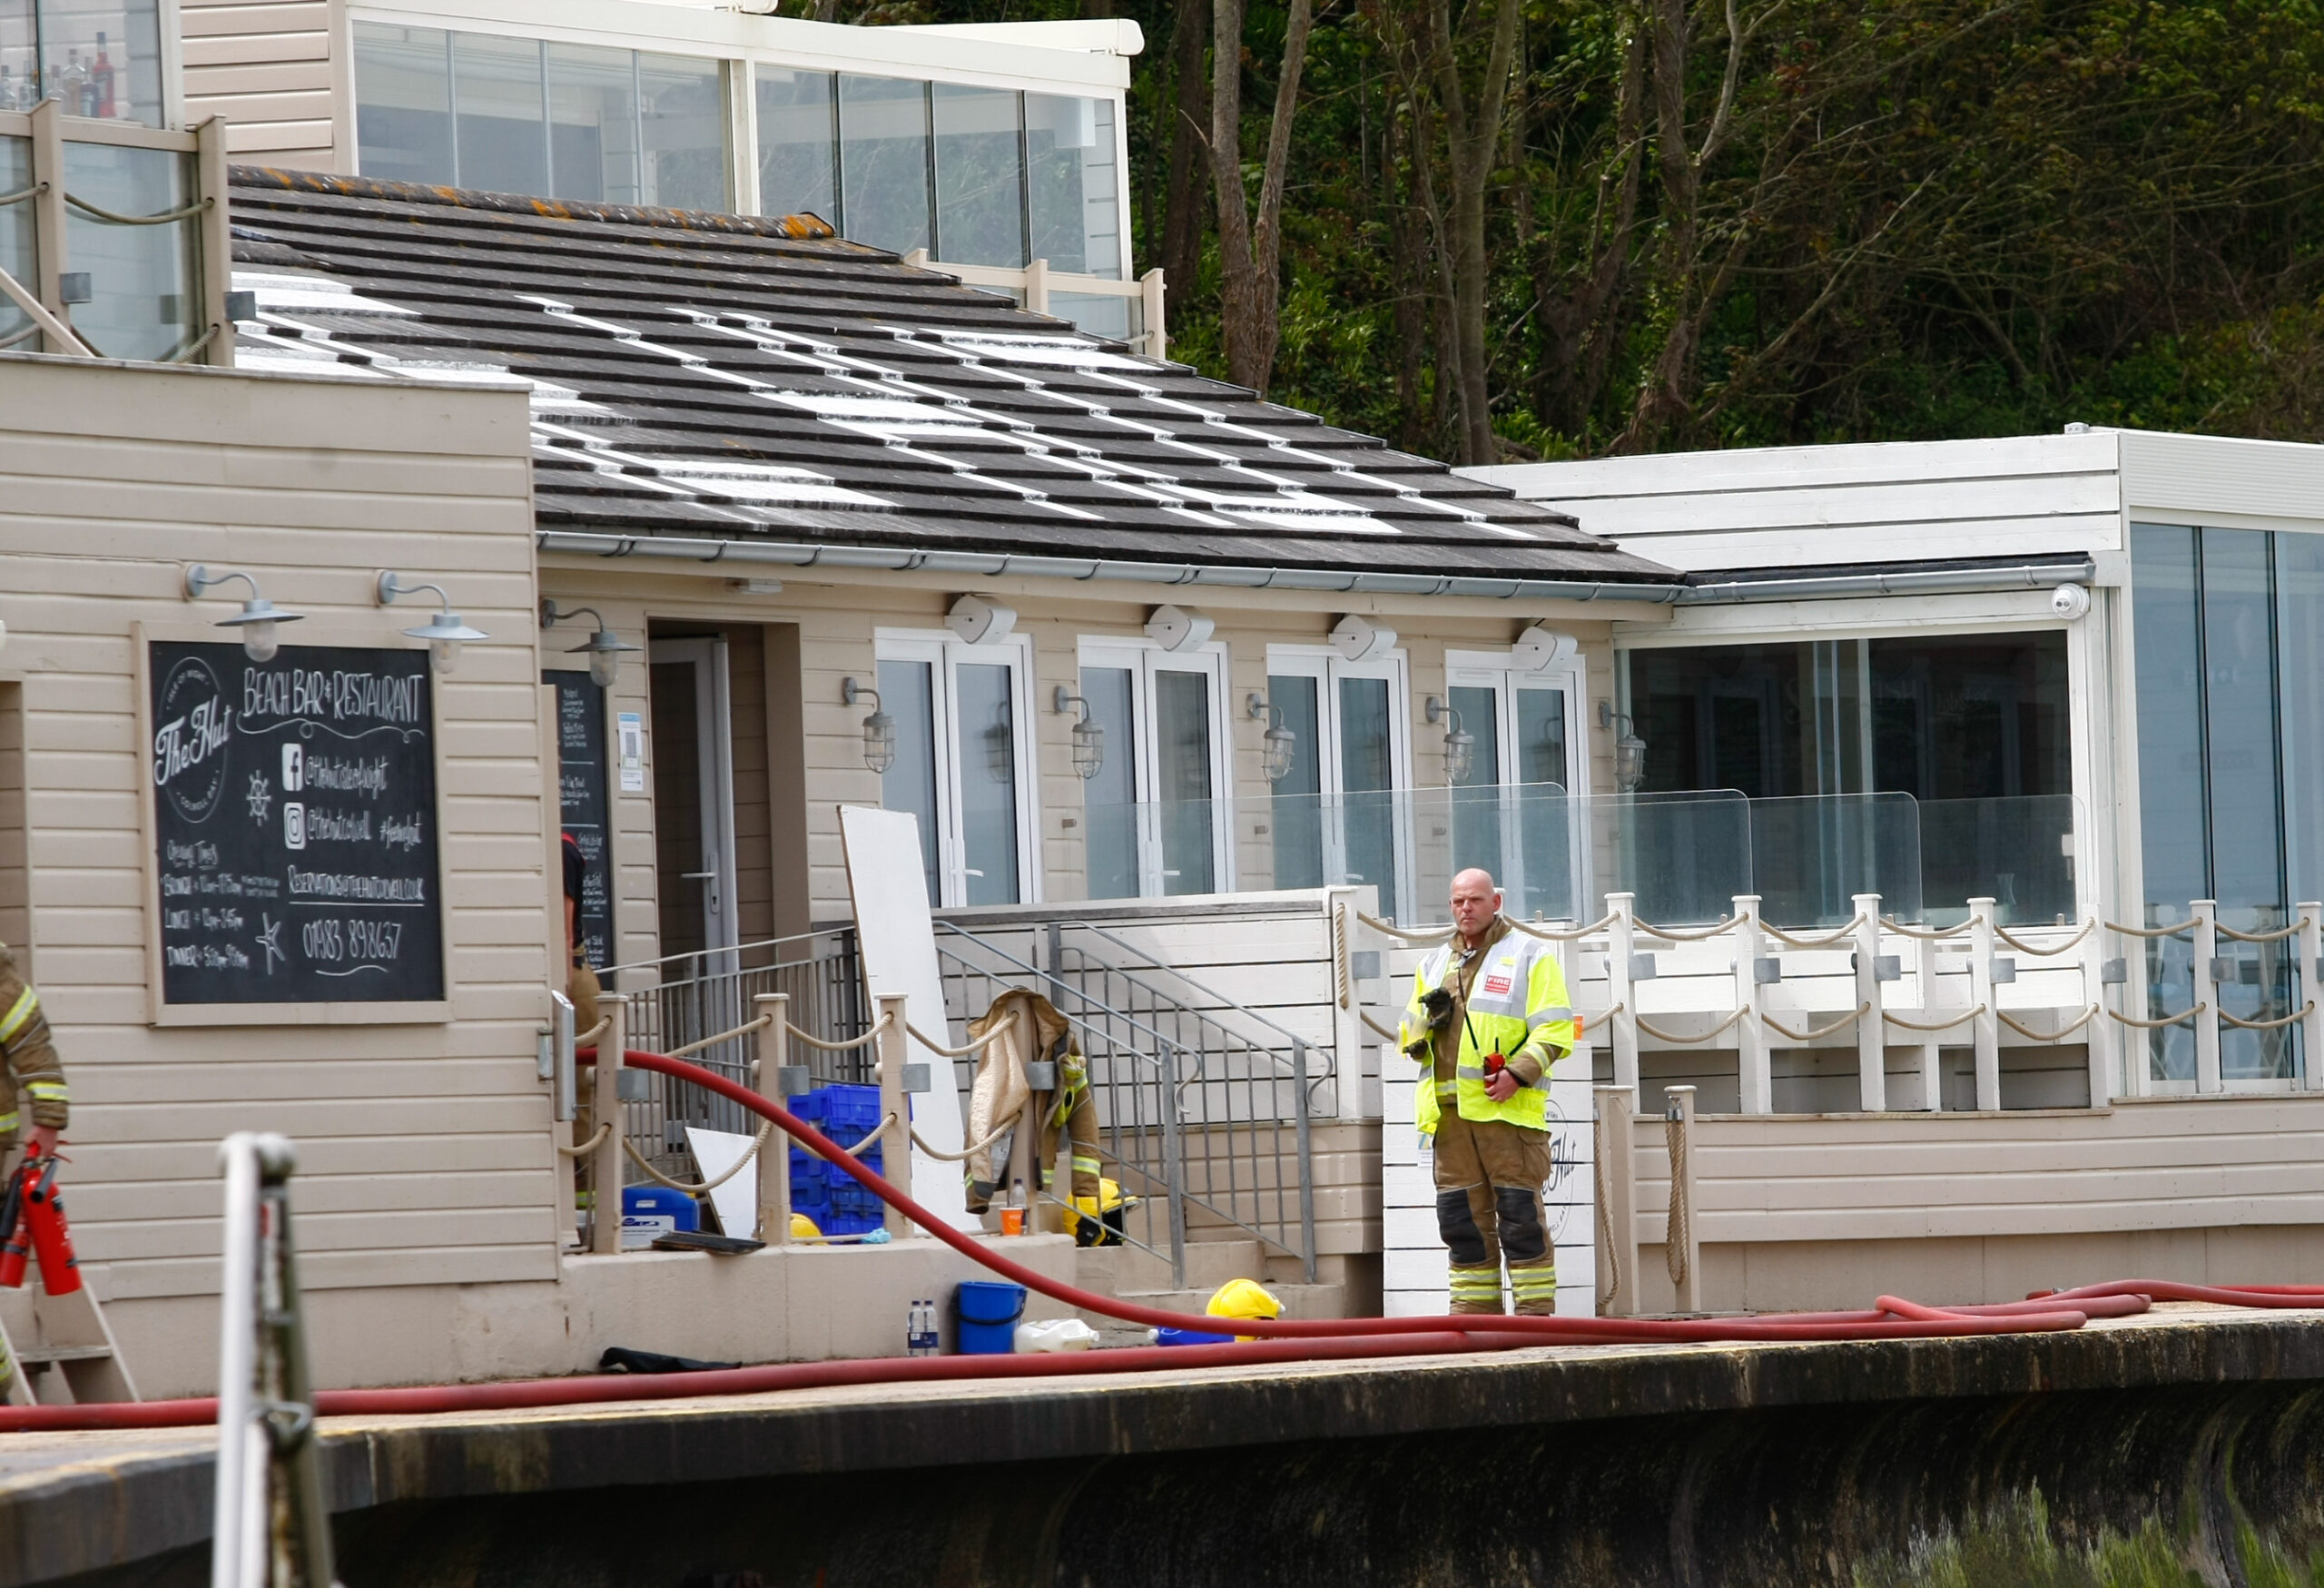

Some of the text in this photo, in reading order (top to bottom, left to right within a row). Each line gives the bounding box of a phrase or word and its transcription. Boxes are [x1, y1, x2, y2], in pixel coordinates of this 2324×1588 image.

[242, 666, 290, 717] BEACH
[292, 667, 325, 715] BAR
[332, 670, 425, 723] RESTAURANT
[153, 694, 233, 786] The Hut
[302, 918, 402, 962] 01983 898637
[1487, 976, 1511, 986] FIRE
